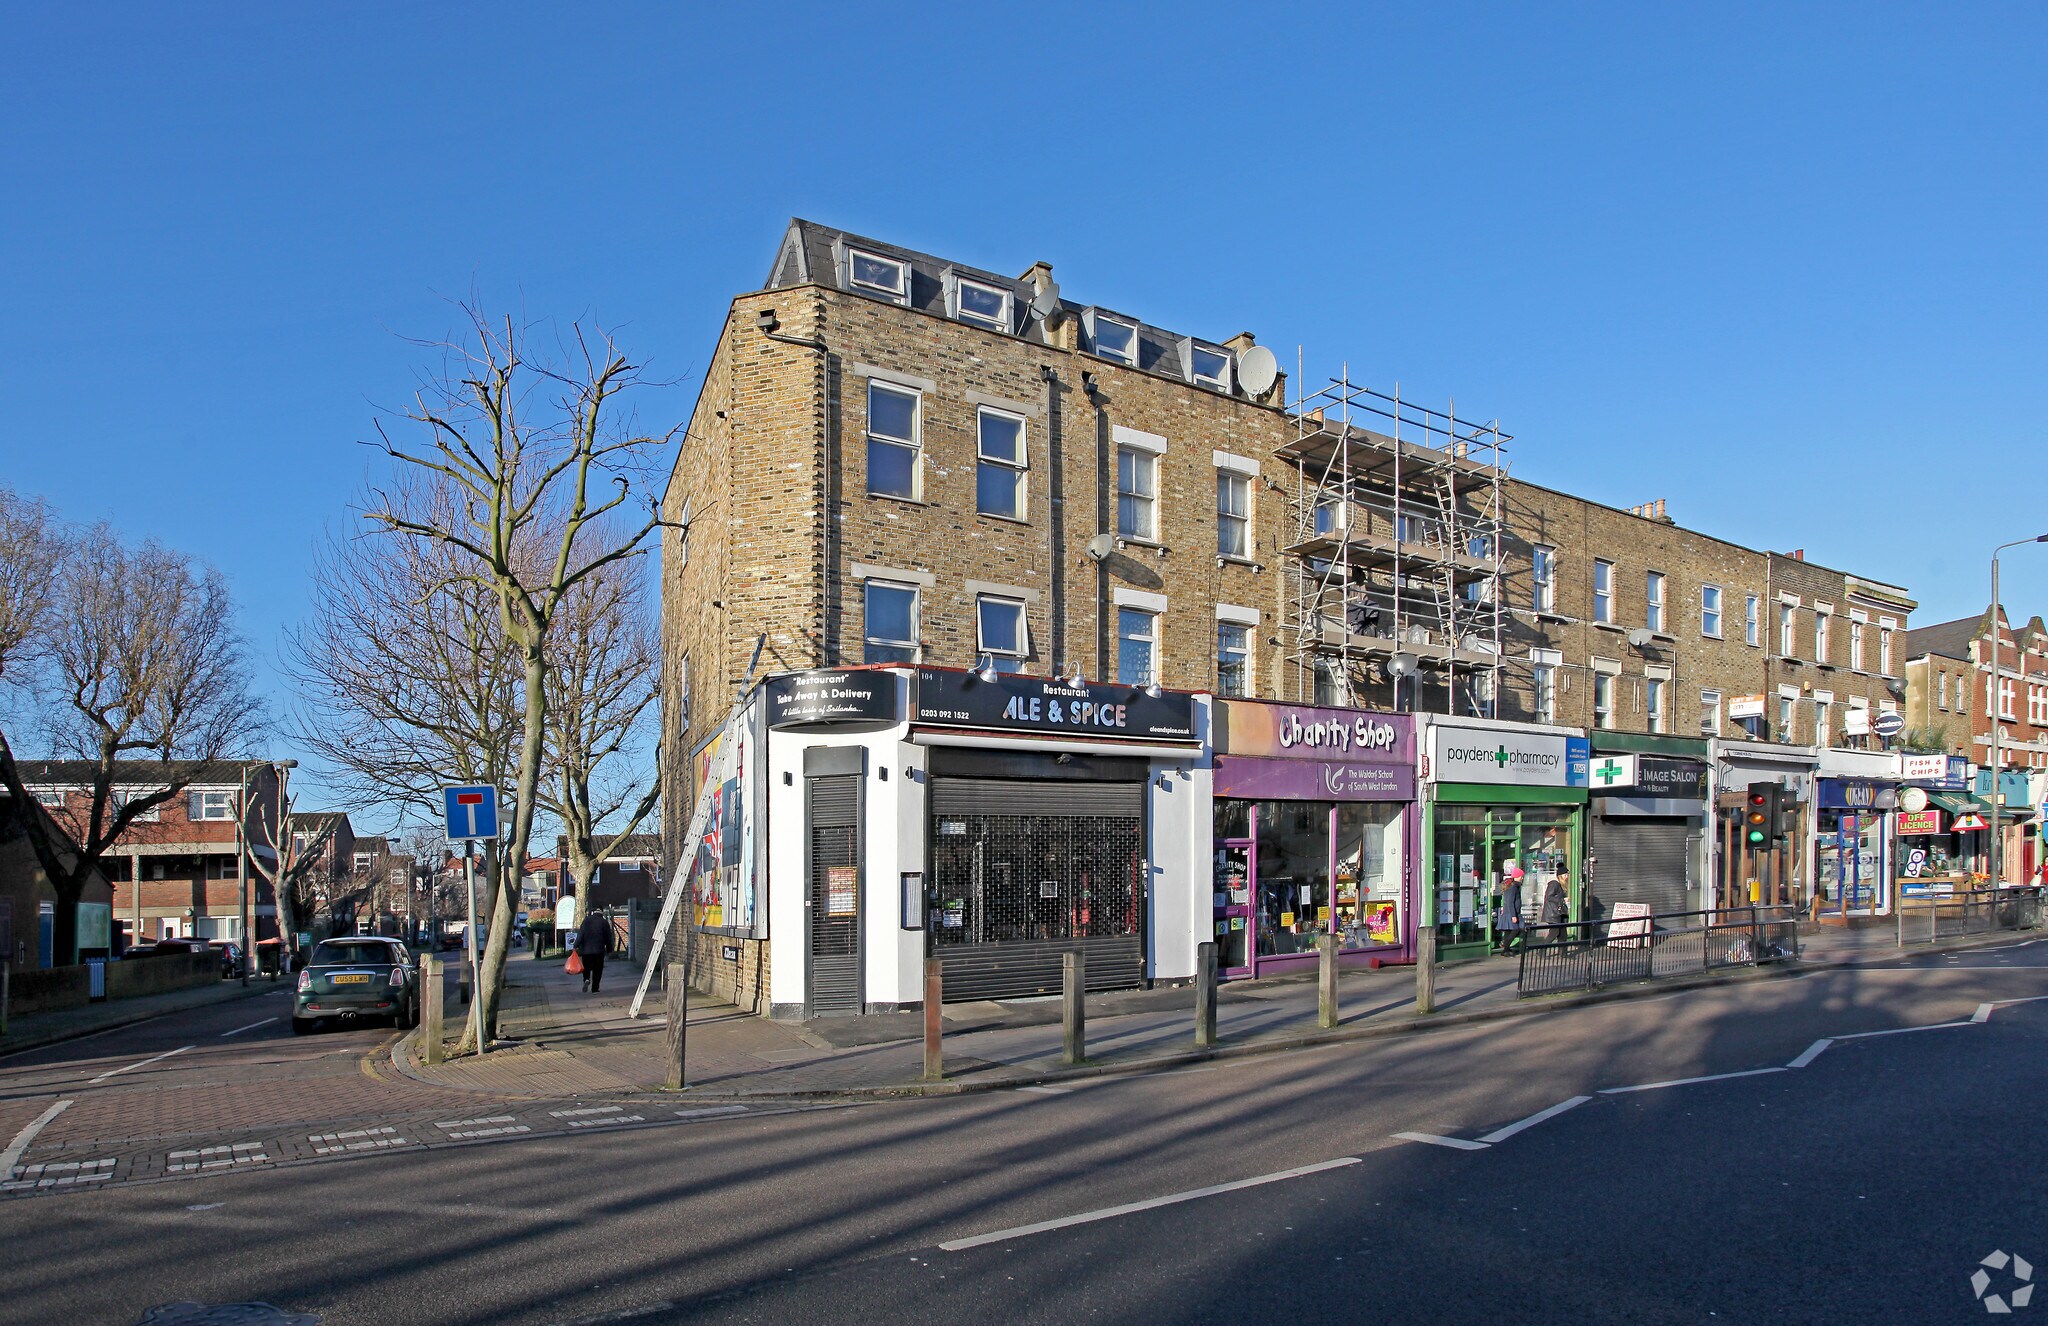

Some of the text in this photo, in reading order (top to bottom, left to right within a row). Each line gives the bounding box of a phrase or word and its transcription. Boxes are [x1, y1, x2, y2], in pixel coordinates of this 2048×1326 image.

[921, 672, 933, 680] 104
[777, 688, 871, 704] Take Away & Delivery
[1043, 683, 1090, 698] Restaurant
[782, 709, 788, 717] A
[818, 705, 826, 715] of
[920, 709, 969, 720] 0203 092 1522
[1002, 695, 1126, 727] ALE & SPICE
[1280, 714, 1395, 752] Charity Shop
[1447, 746, 1560, 768] paydens pharmacy
[1574, 764, 1585, 773] NHS
[1348, 769, 1393, 780] The Waldorf School
[1643, 768, 1669, 782] IMAGE
[1670, 769, 1697, 782] SALON
[1348, 781, 1398, 792] of South West London
[1907, 813, 1926, 822] OFF
[1900, 821, 1934, 830] LICENCE
[1234, 861, 1247, 872] SHOP
